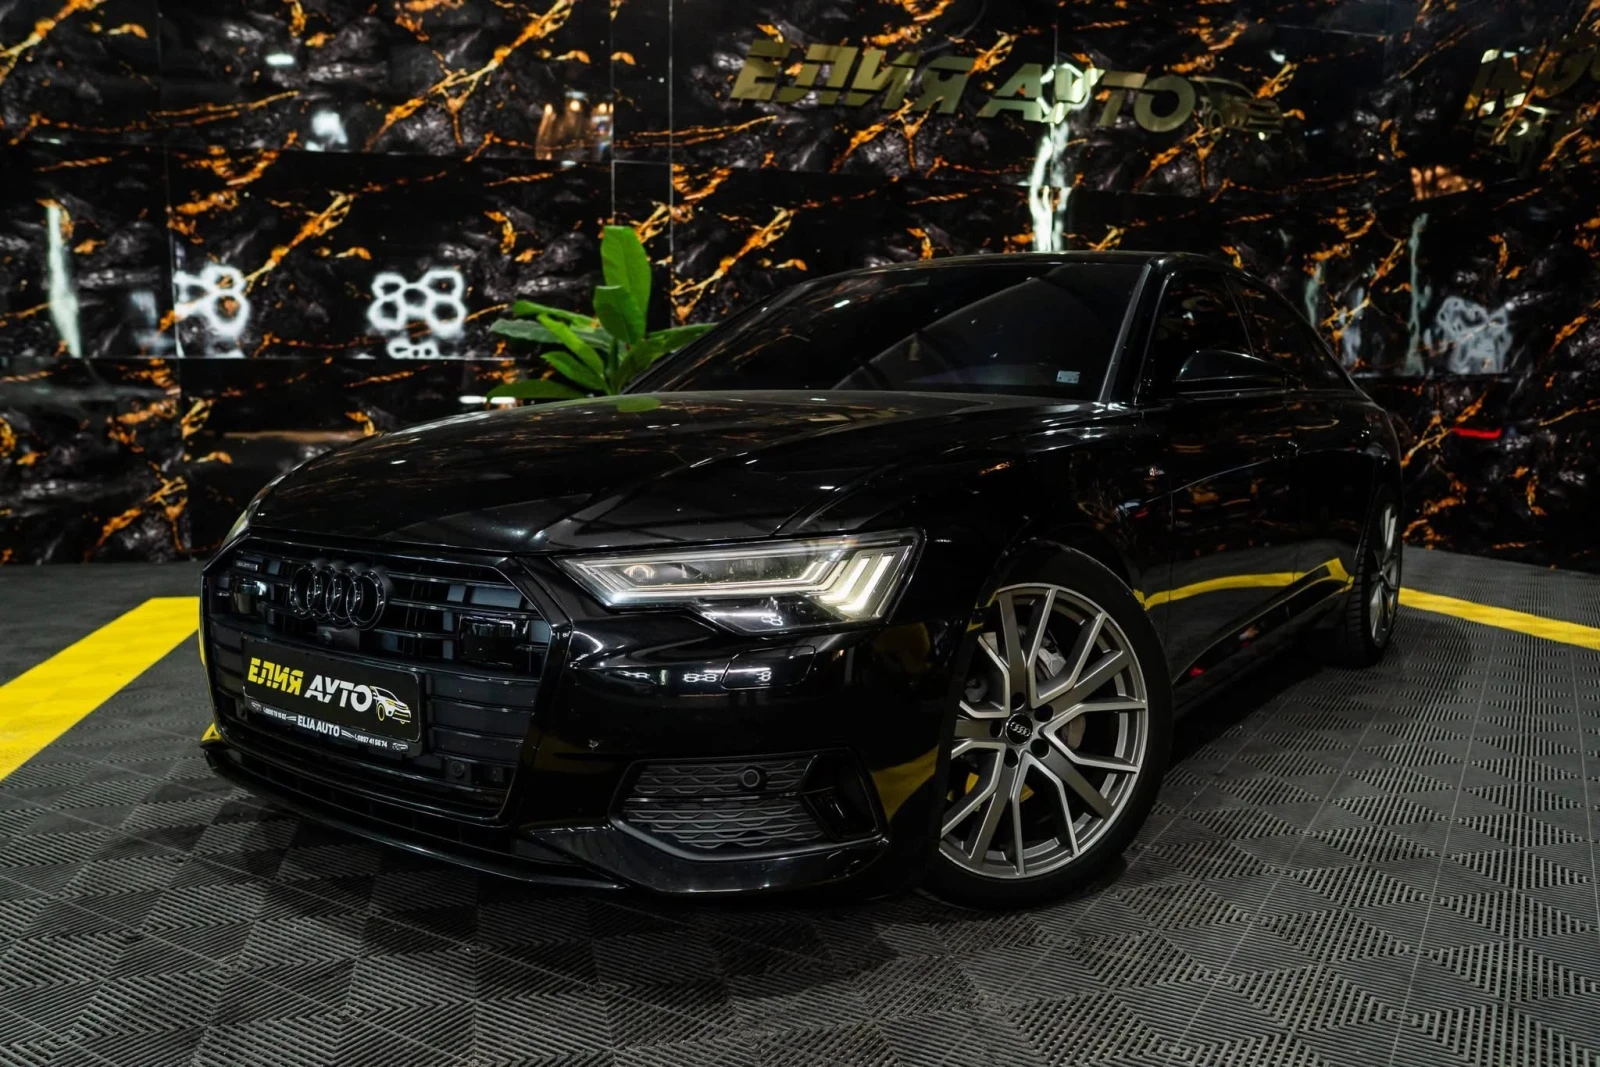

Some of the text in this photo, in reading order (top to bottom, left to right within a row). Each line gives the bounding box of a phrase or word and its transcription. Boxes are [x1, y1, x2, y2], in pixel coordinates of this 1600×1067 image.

[728, 38, 977, 115] ЕЛИЯ
[247, 657, 373, 712] ЕЛИЯ АУТО
[297, 715, 340, 737] ELIA AUTO
